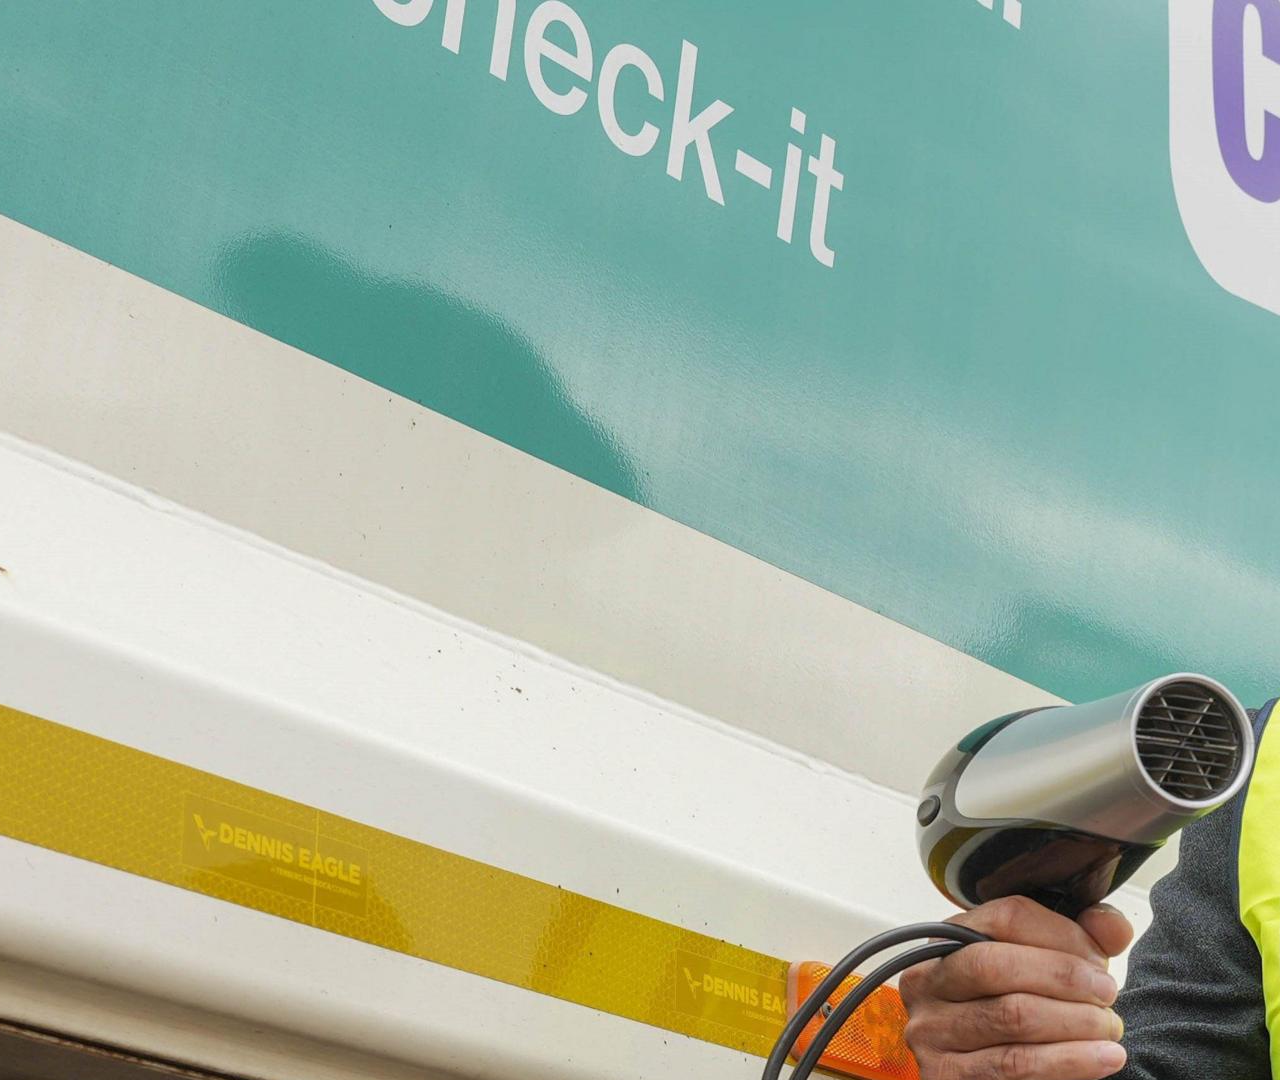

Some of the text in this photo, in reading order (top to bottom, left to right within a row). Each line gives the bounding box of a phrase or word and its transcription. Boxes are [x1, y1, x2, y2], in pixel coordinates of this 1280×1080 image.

[373, 0, 844, 267] eck-it
[219, 823, 294, 865] DENNIS
[299, 848, 362, 886] EAGLE
[703, 974, 759, 1007] DENNIS
